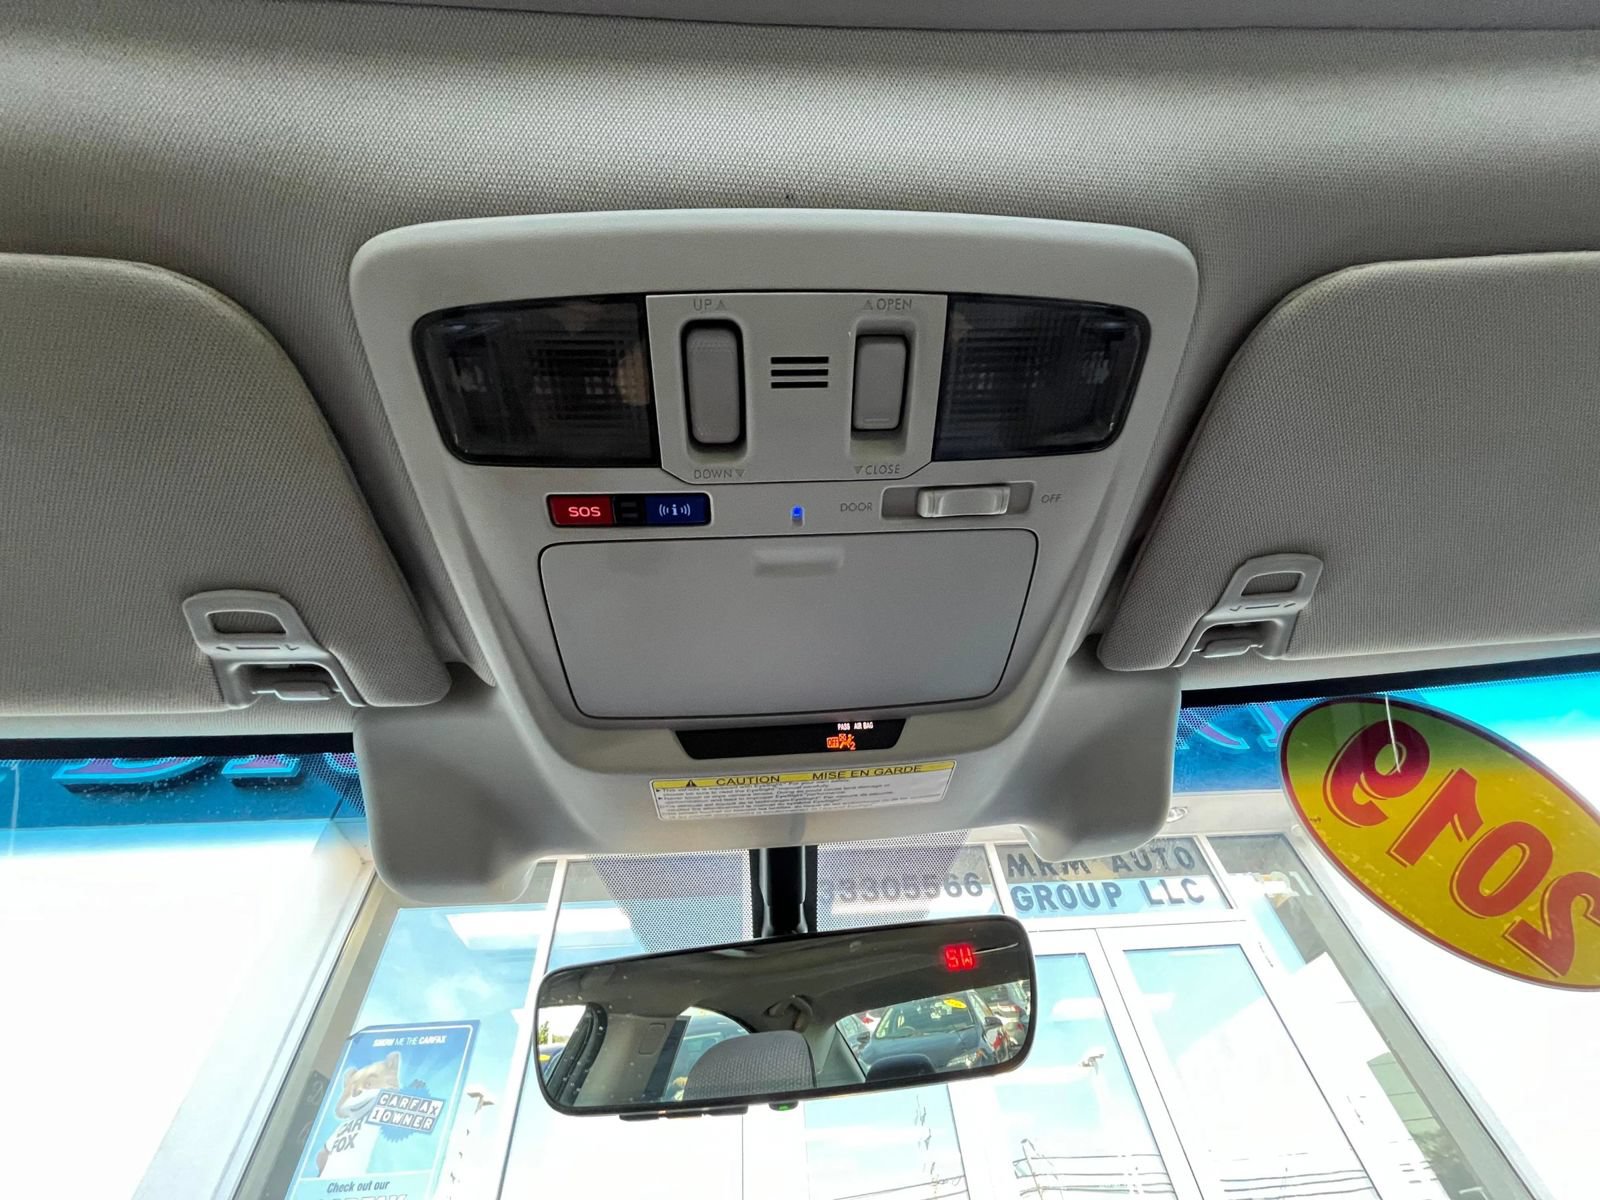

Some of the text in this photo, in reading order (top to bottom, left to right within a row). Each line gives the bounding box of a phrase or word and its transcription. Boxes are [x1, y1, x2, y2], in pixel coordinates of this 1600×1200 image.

[693, 299, 713, 311] UP
[876, 298, 913, 311] OPEN
[694, 468, 733, 480] DOWN
[864, 463, 901, 476] CLOSE
[1041, 493, 1062, 504] OFF
[568, 506, 602, 518] SOS
[840, 501, 873, 512] DOOR
[837, 723, 850, 731] PASS
[716, 765, 921, 787] CAUTION MISE EN GARDE
[1110, 846, 1196, 874] AUTO
[1010, 878, 1205, 913] GROUP LLC
[945, 945, 975, 970] SW
[380, 1092, 439, 1116] CARFAX
[330, 1132, 359, 1153] FOX
[326, 1180, 391, 1193] Check out our
